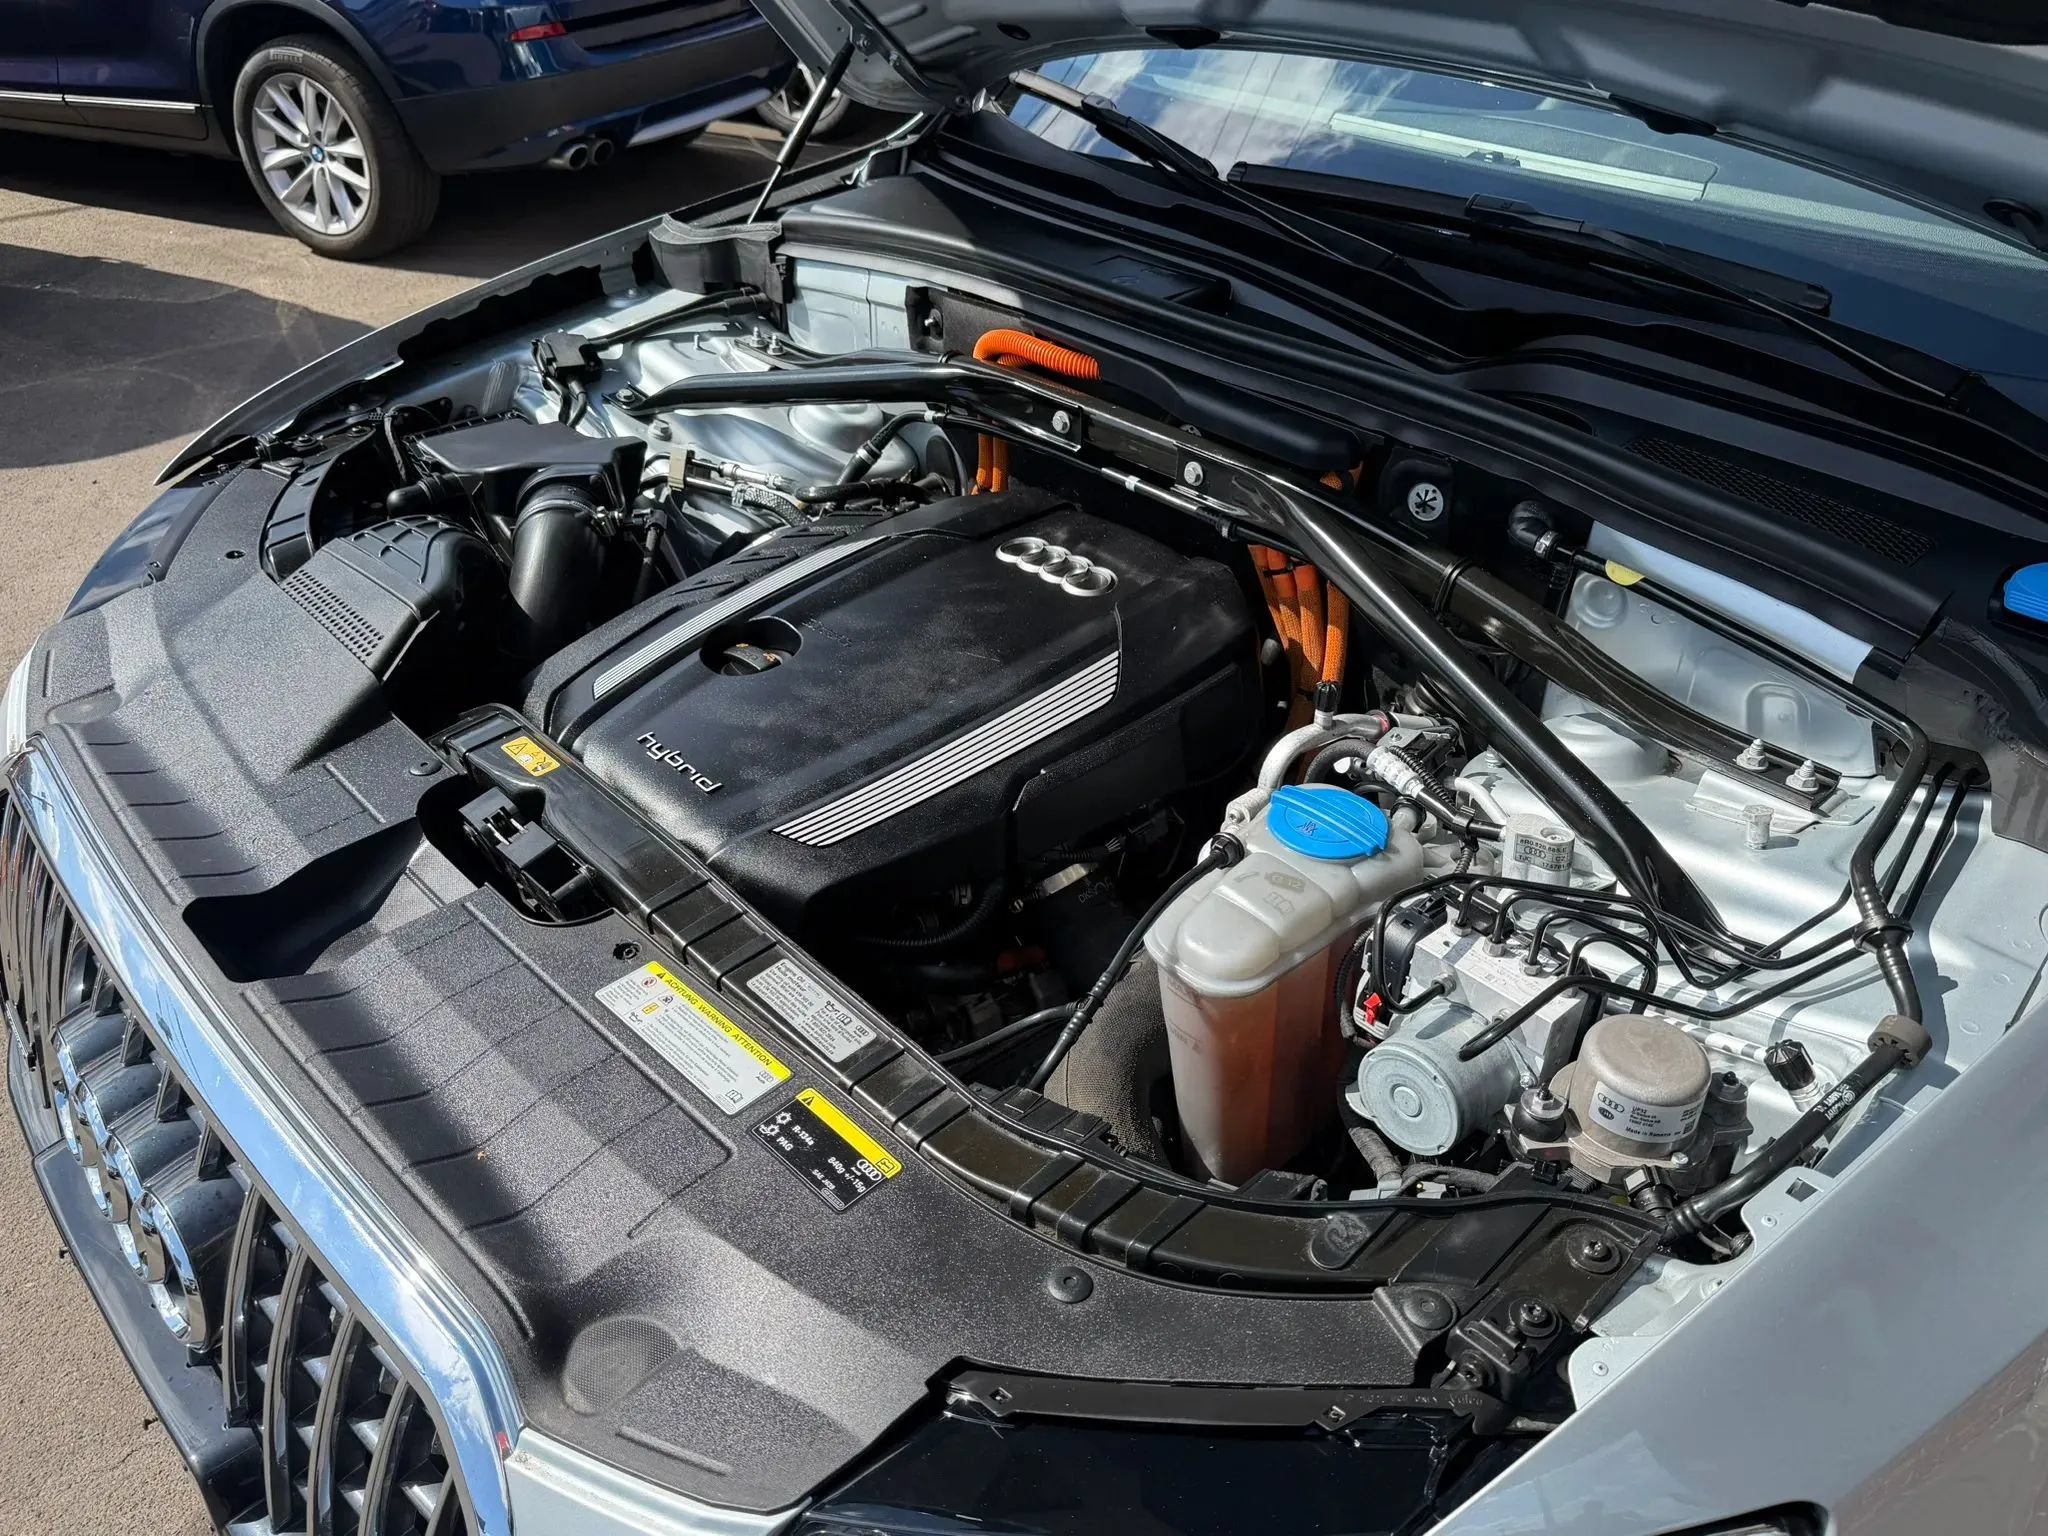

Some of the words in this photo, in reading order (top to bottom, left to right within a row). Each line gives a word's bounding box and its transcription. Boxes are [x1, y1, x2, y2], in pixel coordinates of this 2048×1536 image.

[637, 731, 722, 792] hybrid
[664, 977, 698, 1005] ACHTUNG
[696, 1004, 733, 1033] WARNING
[730, 1032, 773, 1066] ATTENTION
[775, 1135, 794, 1151] PAG
[810, 1168, 824, 1180] SAE
[790, 1124, 816, 1146] R-134a
[825, 1156, 847, 1174] 840g
